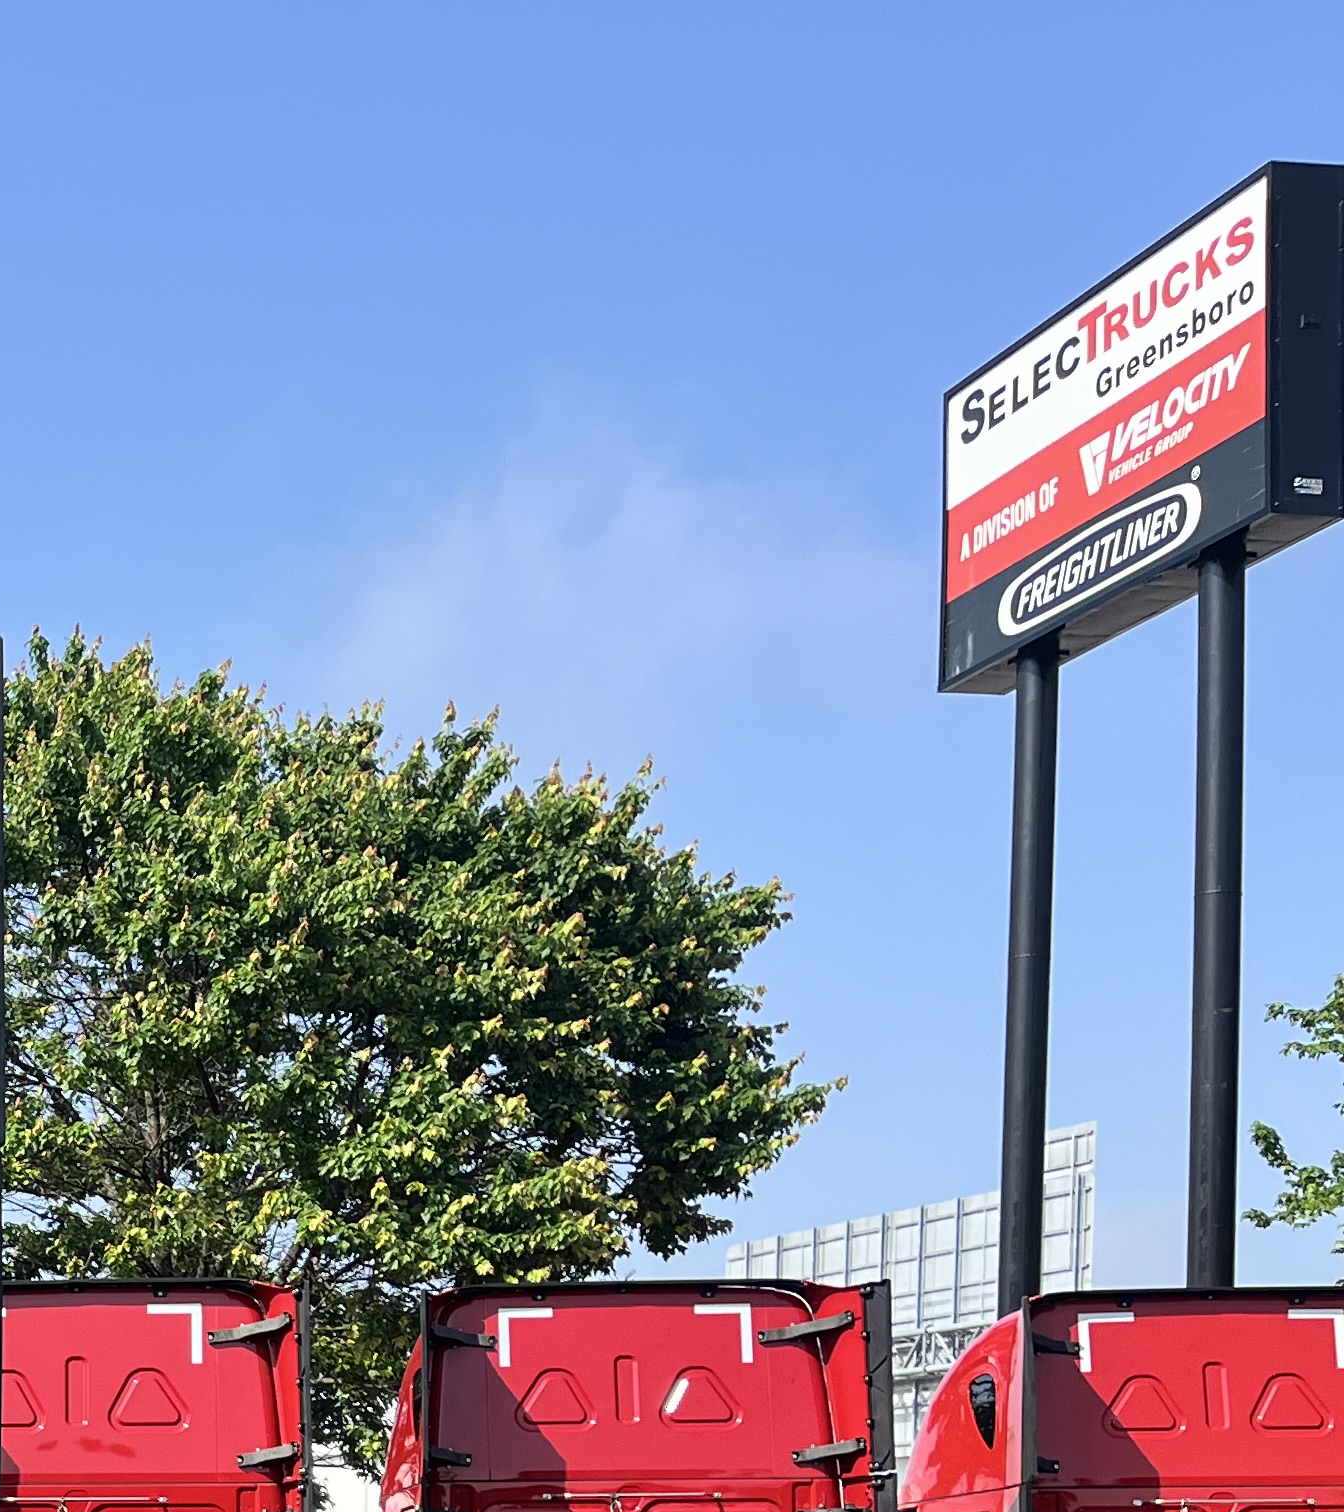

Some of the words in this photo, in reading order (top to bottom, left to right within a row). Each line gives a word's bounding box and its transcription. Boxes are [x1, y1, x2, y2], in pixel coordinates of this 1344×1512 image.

[1096, 281, 1254, 398] Greensboro
[1108, 443, 1152, 485] VEHICLE
[1154, 422, 1193, 456] GROUP
[1111, 343, 1251, 462] VELOCITY
[960, 532, 970, 562] A
[973, 492, 1035, 552] DIVISION
[1039, 476, 1059, 513] OF
[1016, 501, 1180, 619] FREIGHTLINER
